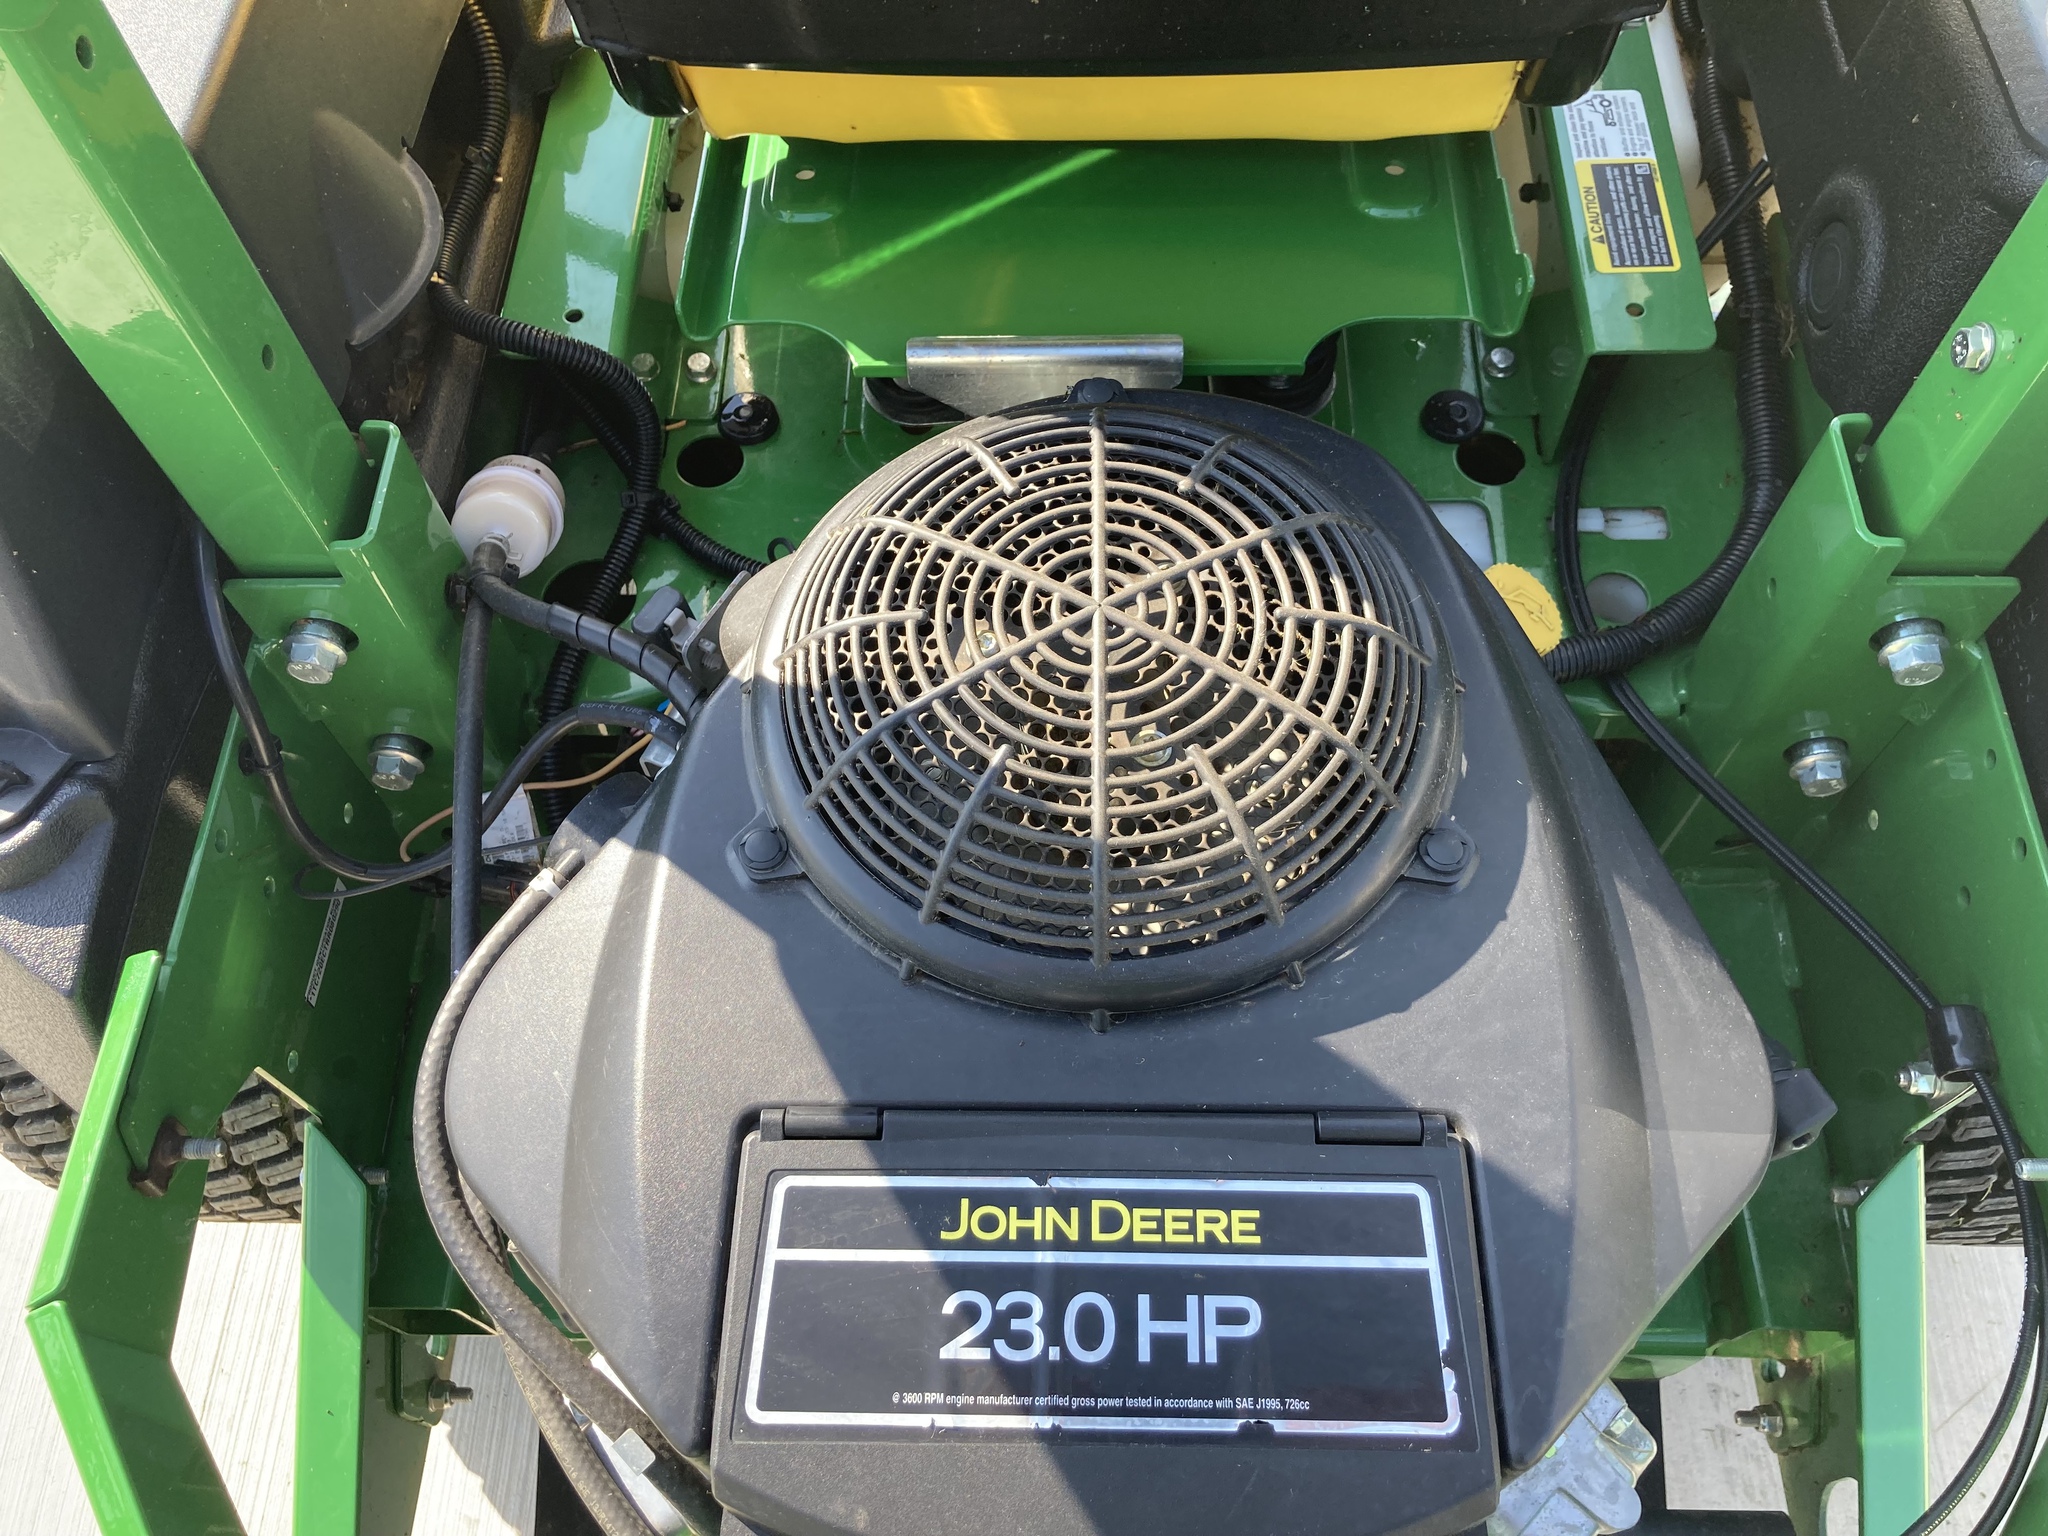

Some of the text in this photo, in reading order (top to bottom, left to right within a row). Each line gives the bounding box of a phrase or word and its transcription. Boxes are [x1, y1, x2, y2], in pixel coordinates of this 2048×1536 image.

[1583, 186, 1602, 233] CAUTION
[940, 1198, 1261, 1244] JOHN DEERE
[939, 1290, 1262, 1363] 23.0 HP
[892, 1391, 1310, 1411] @ 3600 RPM engine manufacturer certified gross power tested in accordance with SAE J1995, 726cc
